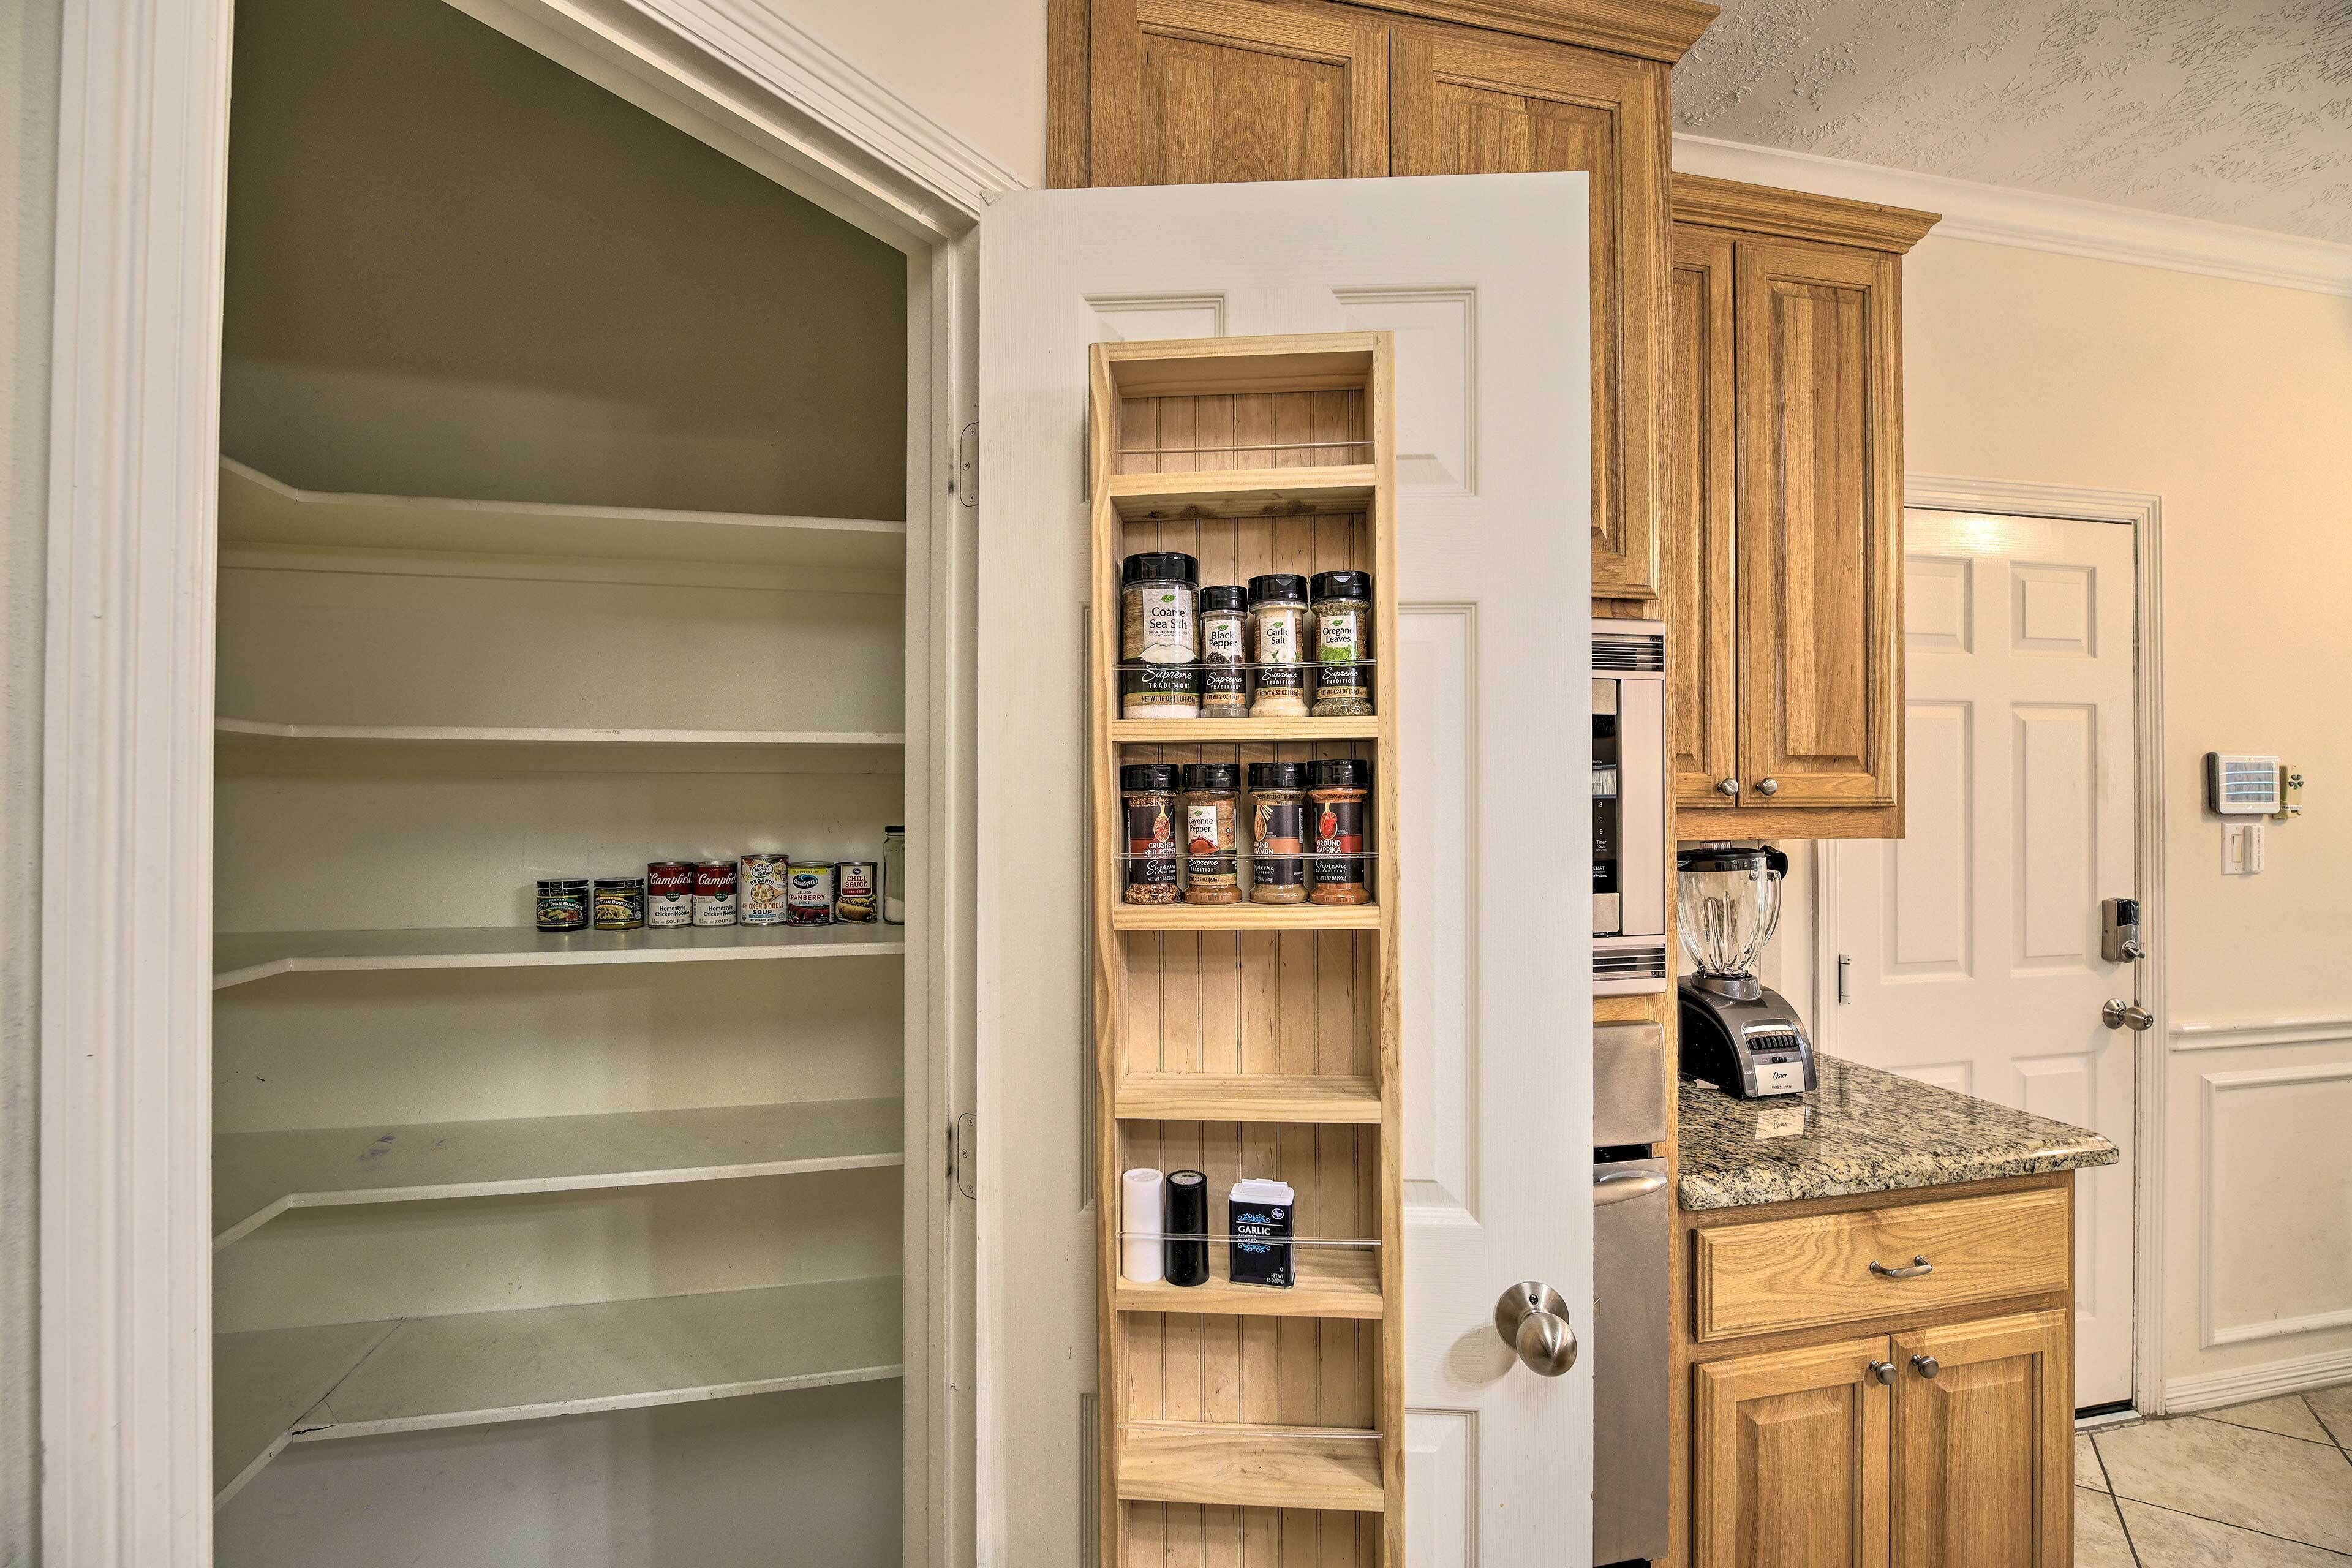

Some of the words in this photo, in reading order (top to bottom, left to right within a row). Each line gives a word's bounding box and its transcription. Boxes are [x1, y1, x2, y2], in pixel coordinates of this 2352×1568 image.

[1152, 607, 1185, 617] Coare
[1150, 619, 1167, 629] Sea
[1212, 630, 1234, 639] Black
[1209, 639, 1237, 649] Pepper
[1141, 664, 1193, 683] Supreme
[1206, 671, 1242, 685] Supreme
[1262, 668, 1298, 681] Supreme
[1322, 666, 1359, 680] Supreme
[1188, 816, 1214, 826] Cayenne
[1189, 824, 1211, 834] Pepper
[1188, 858, 1219, 868] Supreme
[1316, 858, 1348, 873] Supreme
[563, 902, 583, 911] BOUILLON
[612, 900, 633, 910] BOUILLON
[1238, 1225, 1271, 1235] GARLIC
